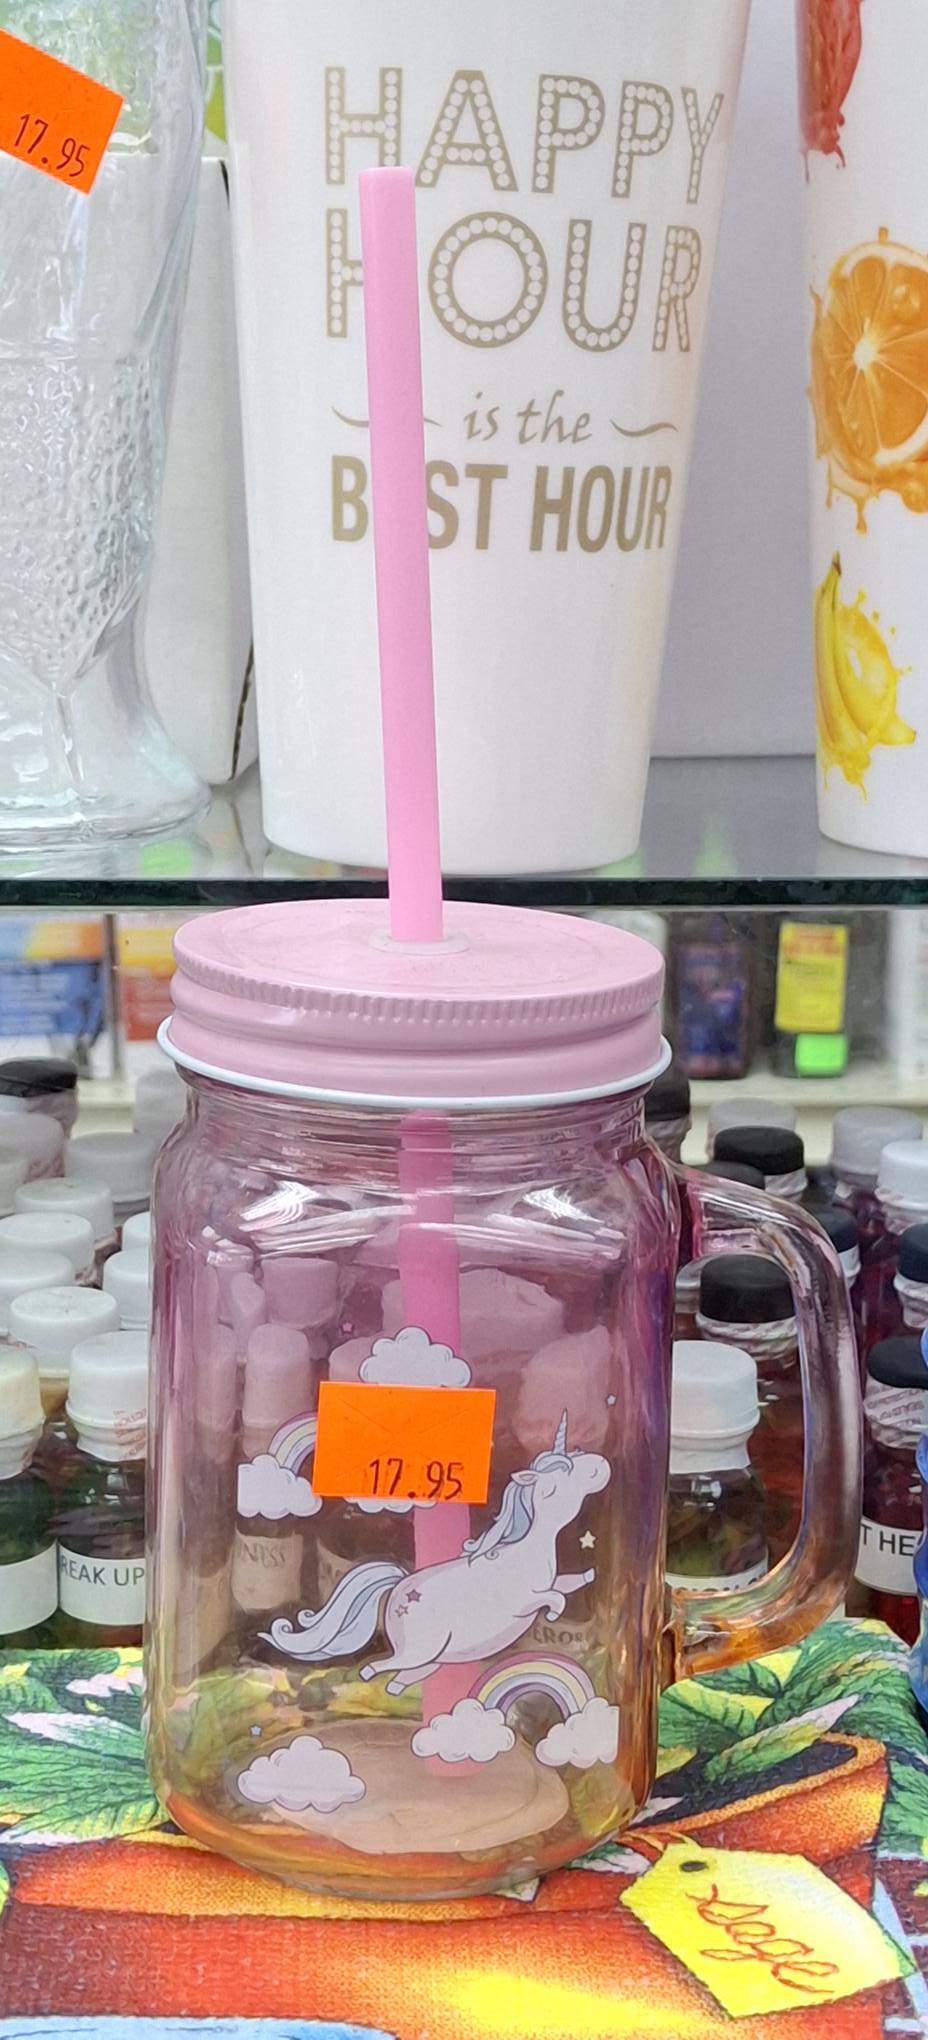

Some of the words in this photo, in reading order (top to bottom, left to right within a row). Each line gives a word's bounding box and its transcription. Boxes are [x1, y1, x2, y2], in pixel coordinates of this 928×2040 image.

[13, 113, 91, 178] 17.95
[325, 66, 724, 204] HAPPY
[463, 391, 500, 441] is
[516, 389, 593, 445] the
[331, 455, 508, 550] BST
[529, 463, 672, 553] HOUR
[369, 1458, 464, 1500] 17.95
[880, 1530, 917, 1557] HE
[114, 1566, 146, 1586] UP
[686, 1883, 840, 1994] sage
